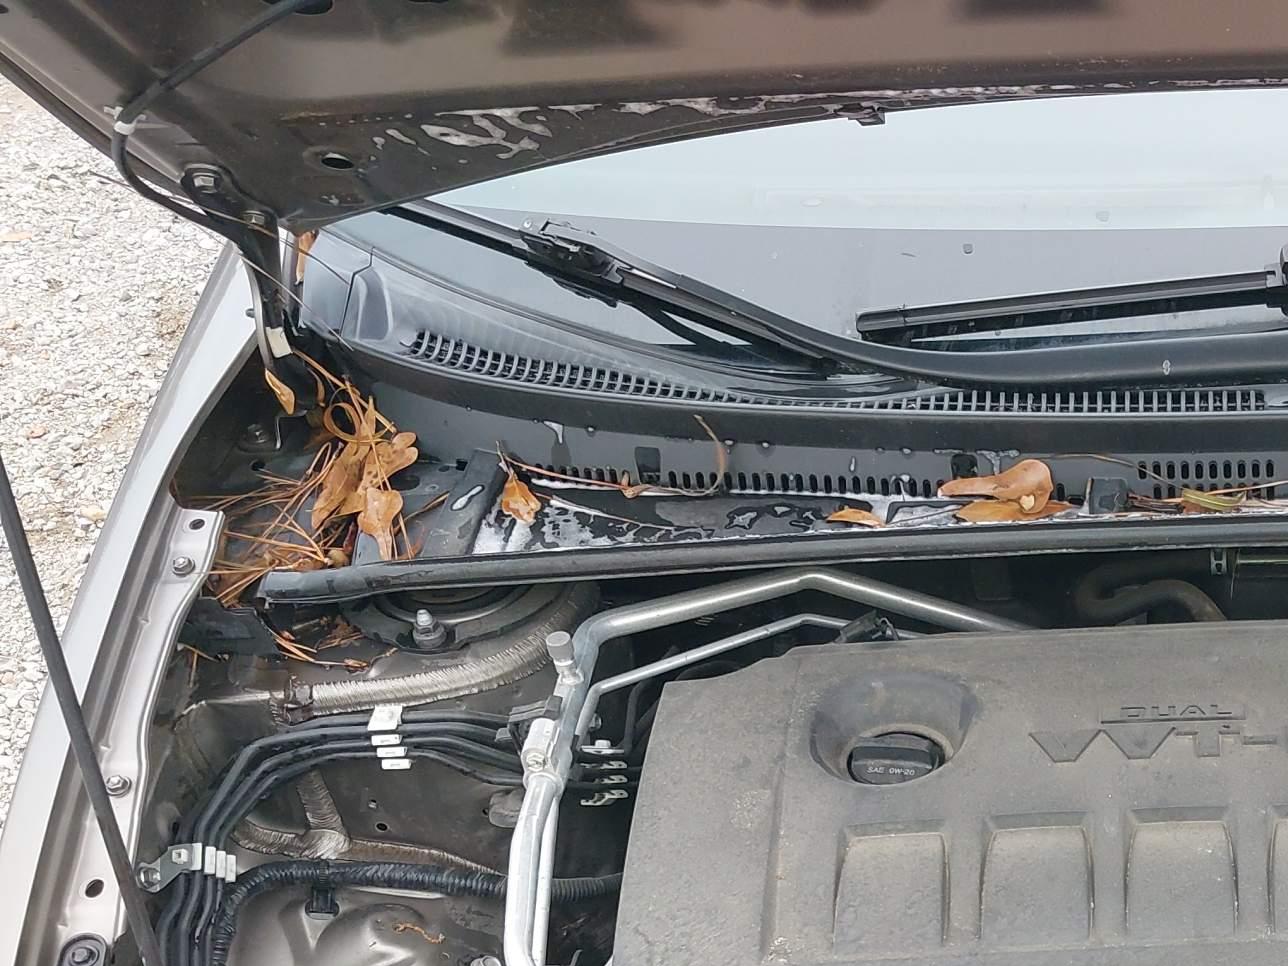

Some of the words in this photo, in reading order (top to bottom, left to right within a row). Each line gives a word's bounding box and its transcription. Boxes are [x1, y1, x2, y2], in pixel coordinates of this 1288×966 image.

[1119, 704, 1233, 719] DUAL
[866, 766, 885, 774] SAE
[888, 767, 916, 776] 0W-20
